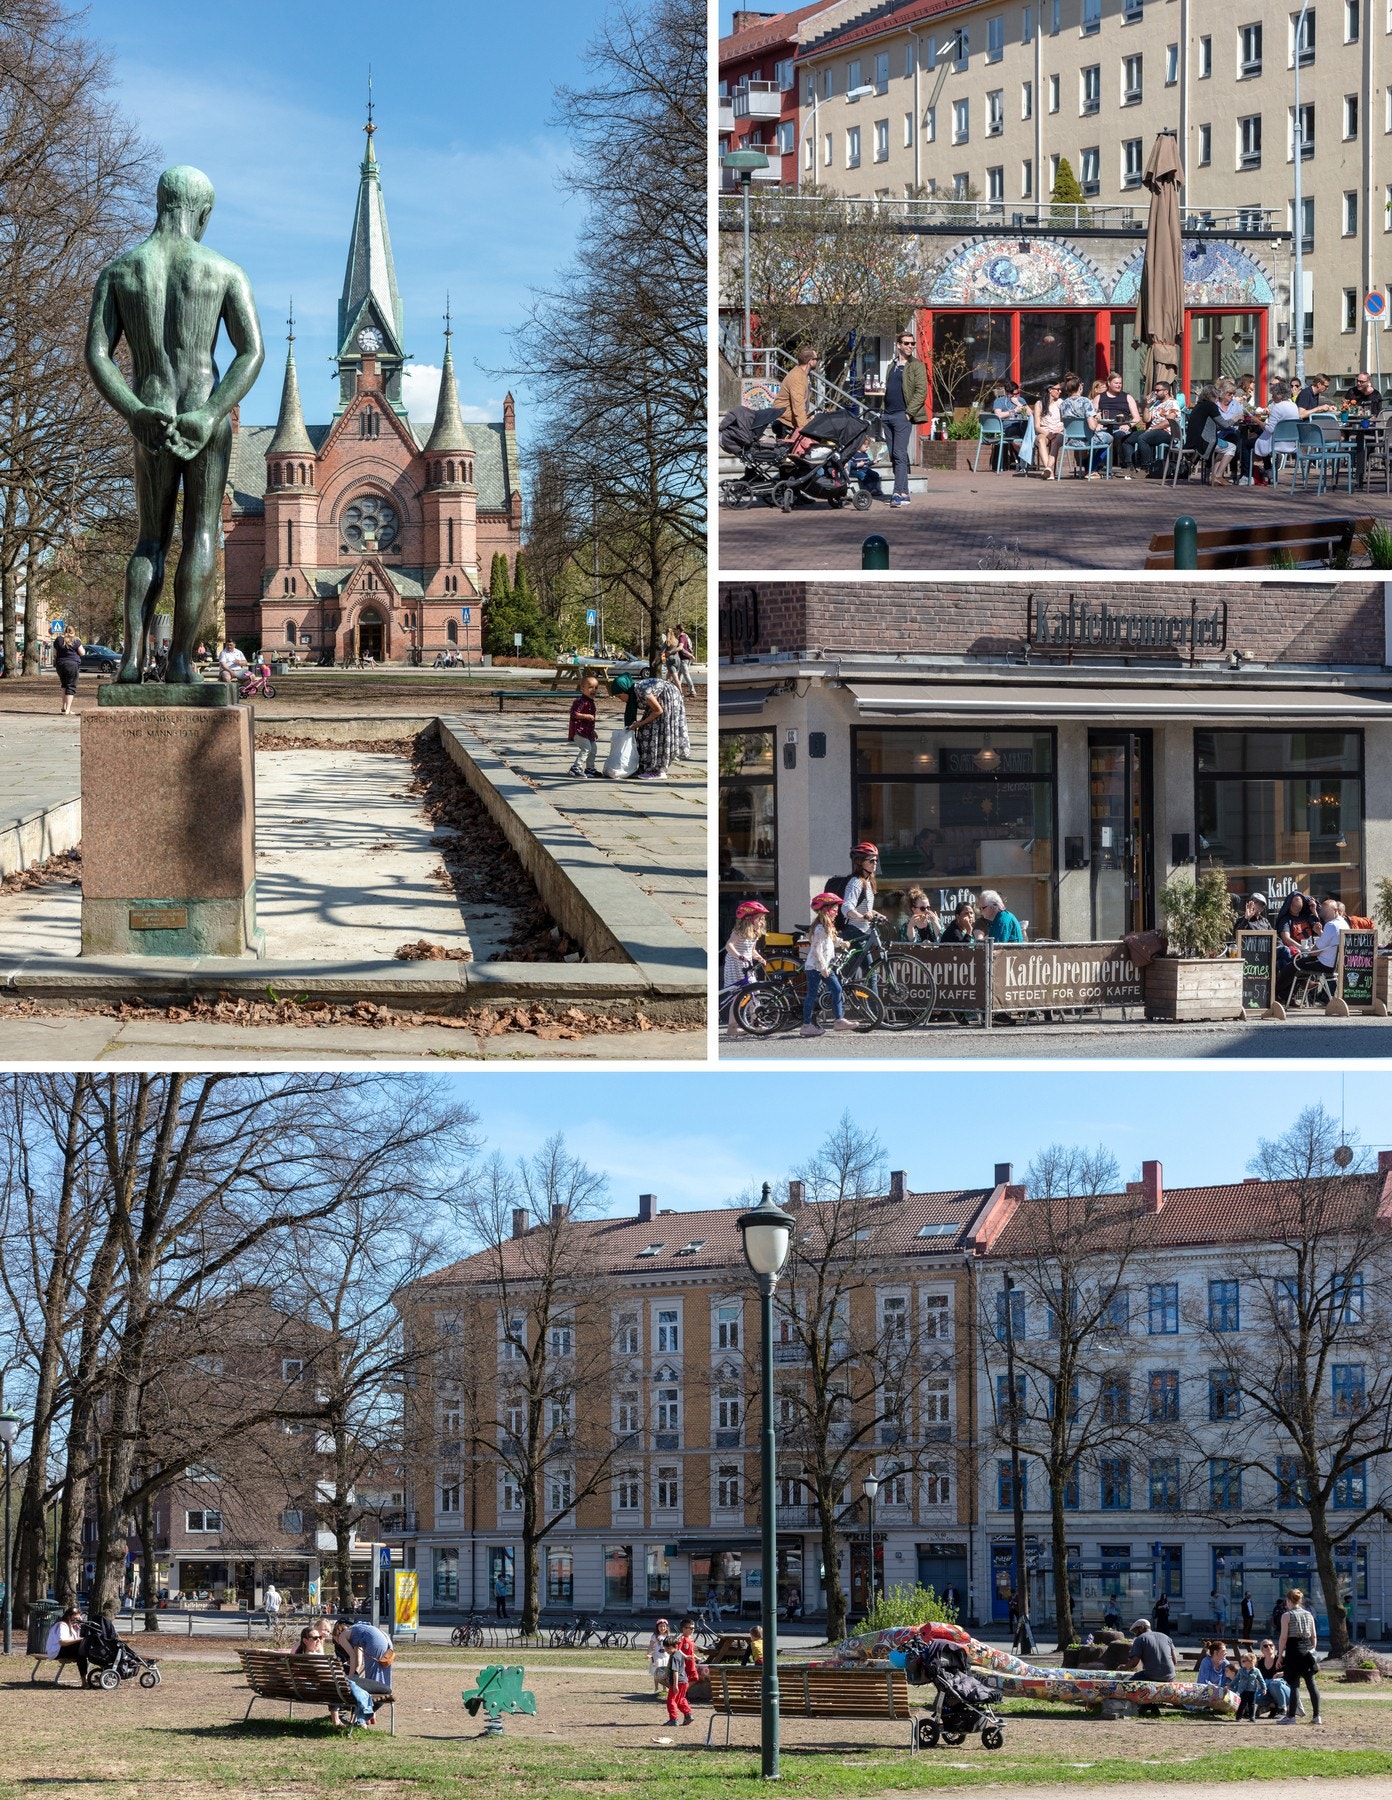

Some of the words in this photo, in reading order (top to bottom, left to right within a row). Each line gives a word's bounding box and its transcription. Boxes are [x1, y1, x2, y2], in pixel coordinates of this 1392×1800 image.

[1035, 600, 1223, 647] Kaffebrenneriet
[1267, 876, 1298, 898] Kaffe
[1005, 953, 1140, 987] Kaffebrenneriet
[939, 989, 977, 1000] KAFFE
[1005, 990, 1047, 1001] STEDET
[1052, 988, 1074, 998] FOR
[1079, 987, 1101, 997] GOD
[1107, 985, 1141, 996] KAFFE
